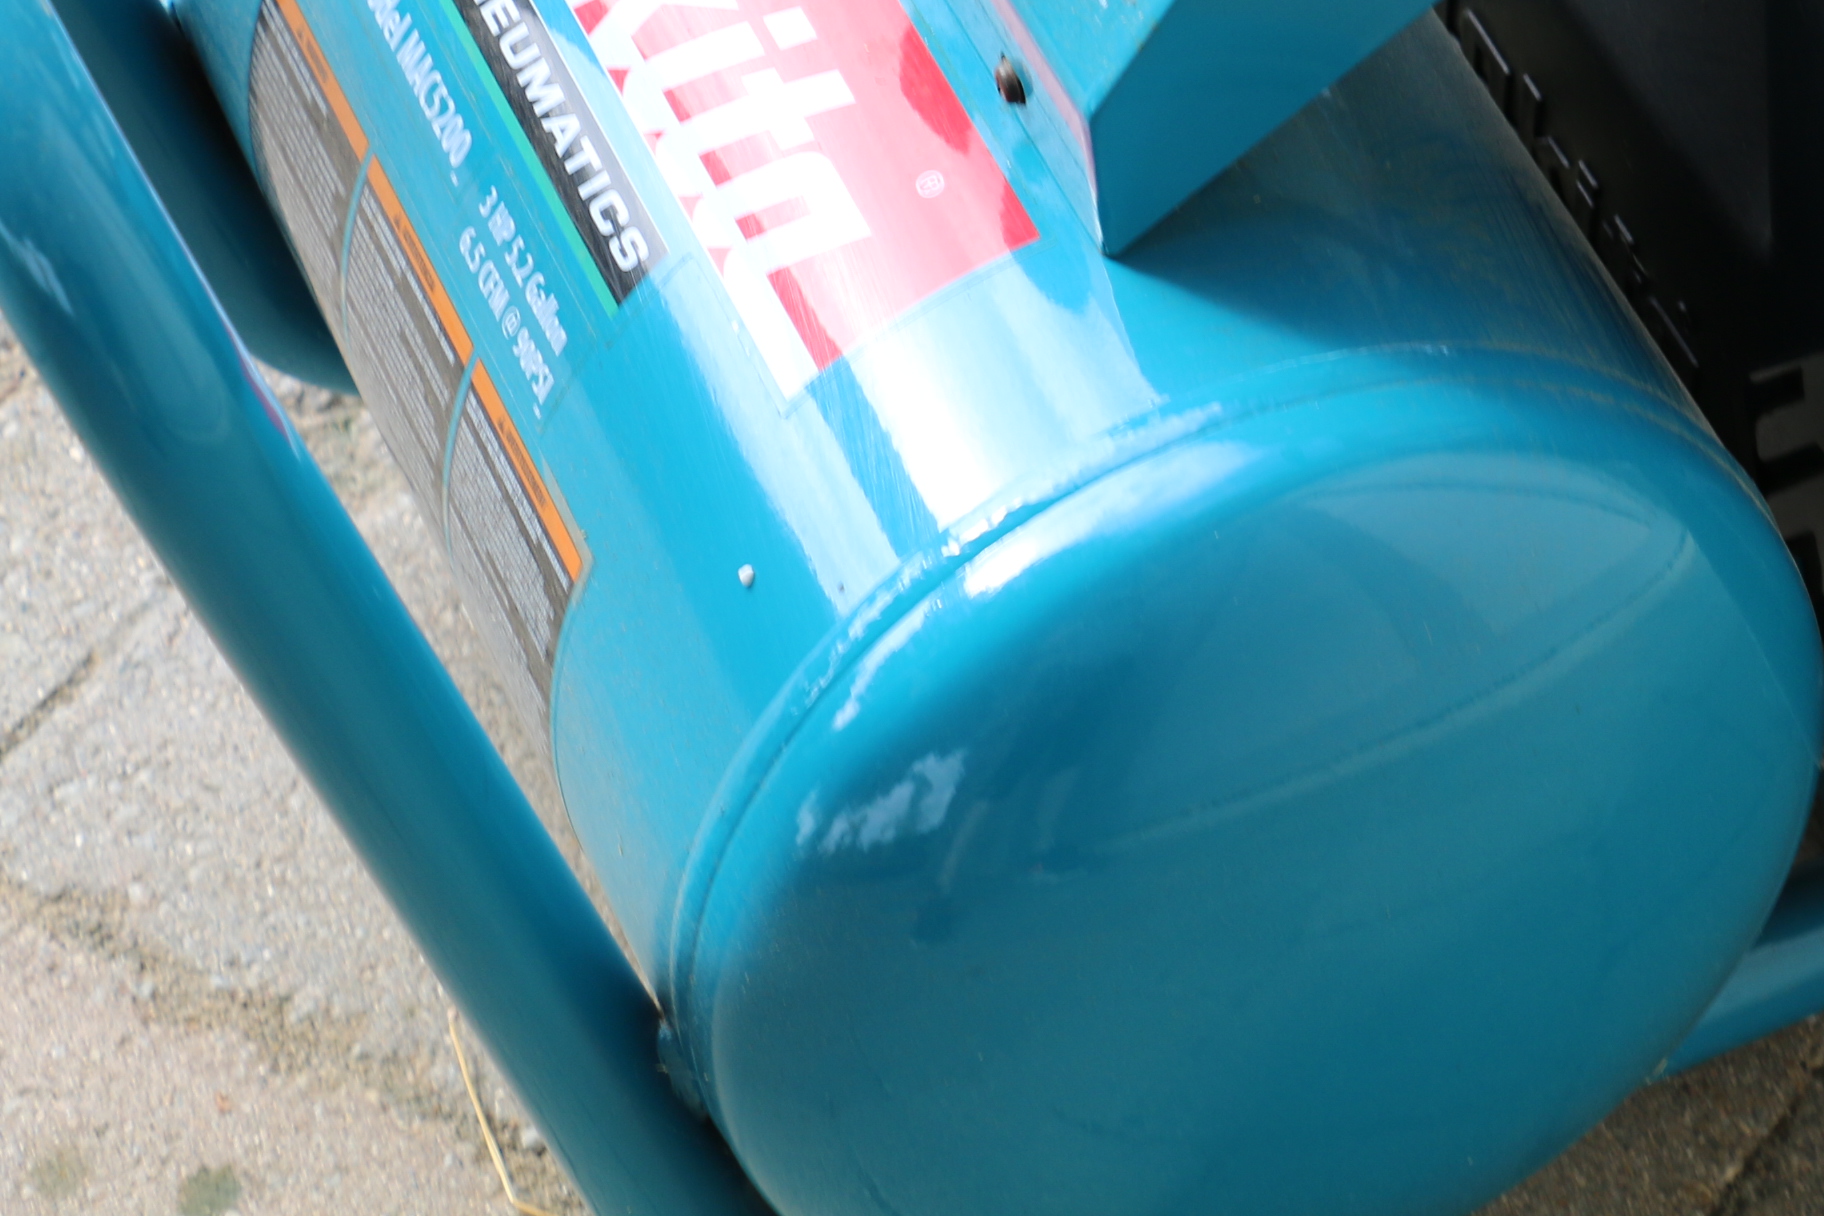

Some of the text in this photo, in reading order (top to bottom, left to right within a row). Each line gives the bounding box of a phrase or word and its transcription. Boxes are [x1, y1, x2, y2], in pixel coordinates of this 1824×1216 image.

[396, 28, 472, 168] MAC5200
[479, 185, 498, 218] 3
[488, 201, 516, 246] HP
[459, 226, 486, 274] 6.5
[478, 260, 510, 322] CFM
[525, 272, 568, 357] Gallon
